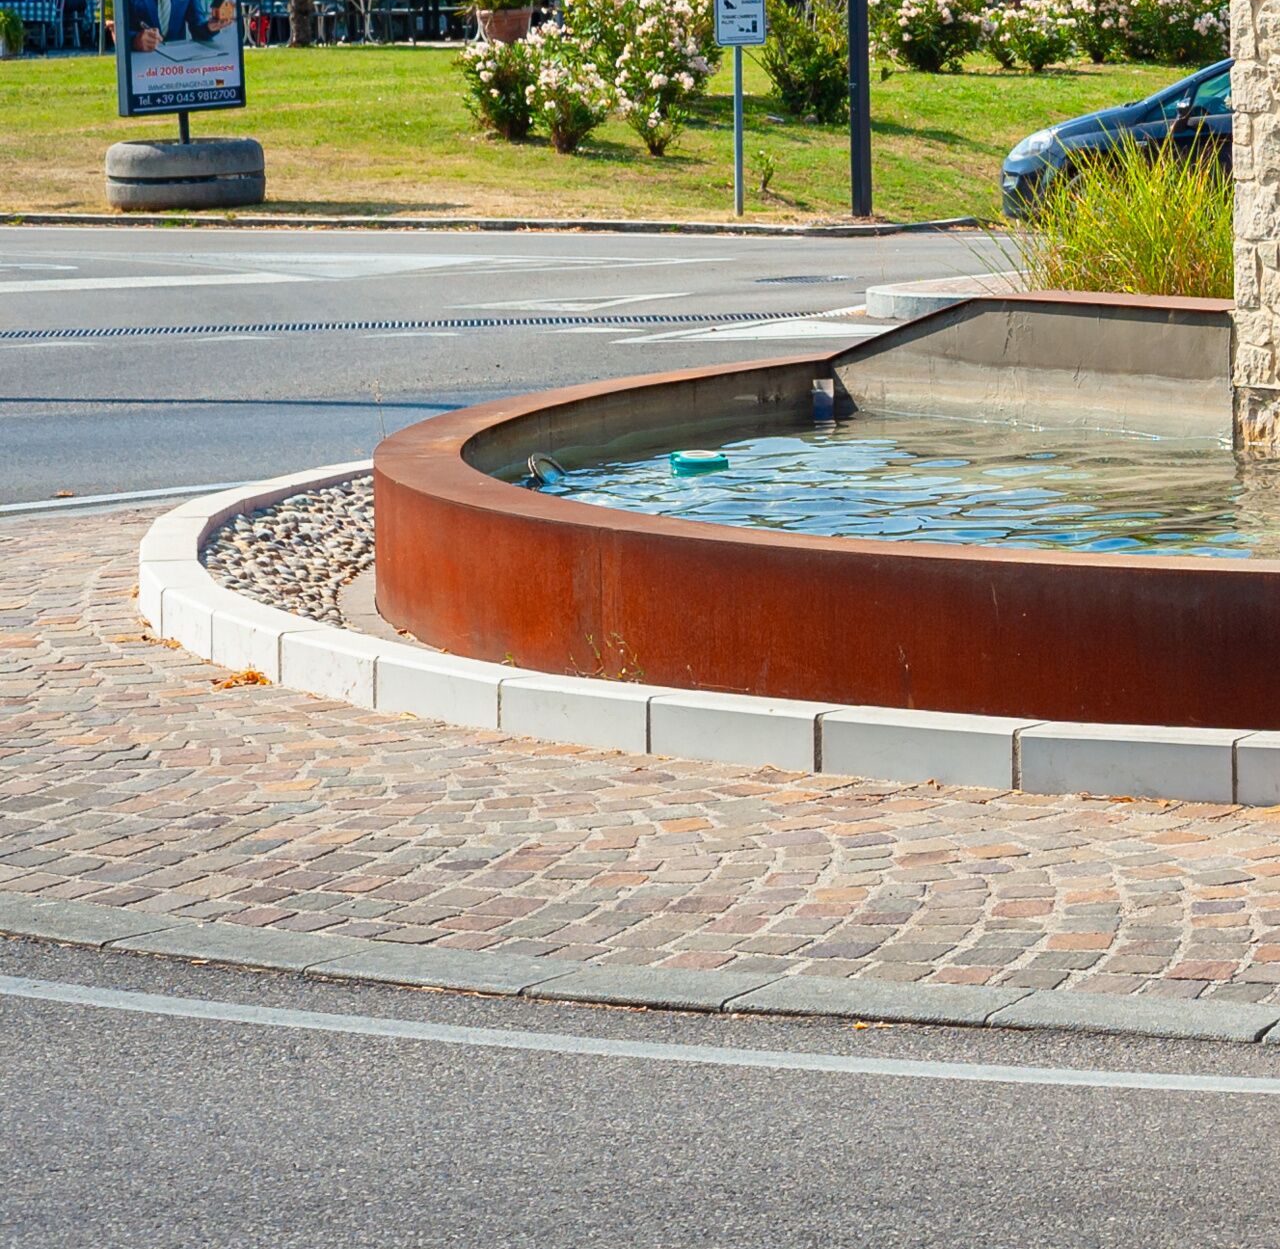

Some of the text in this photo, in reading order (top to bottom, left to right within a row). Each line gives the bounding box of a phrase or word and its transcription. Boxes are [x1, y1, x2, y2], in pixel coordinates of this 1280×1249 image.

[160, 65, 184, 76] 2008
[139, 96, 153, 106] Tel.
[156, 94, 174, 104] +39
[176, 93, 196, 103] 045
